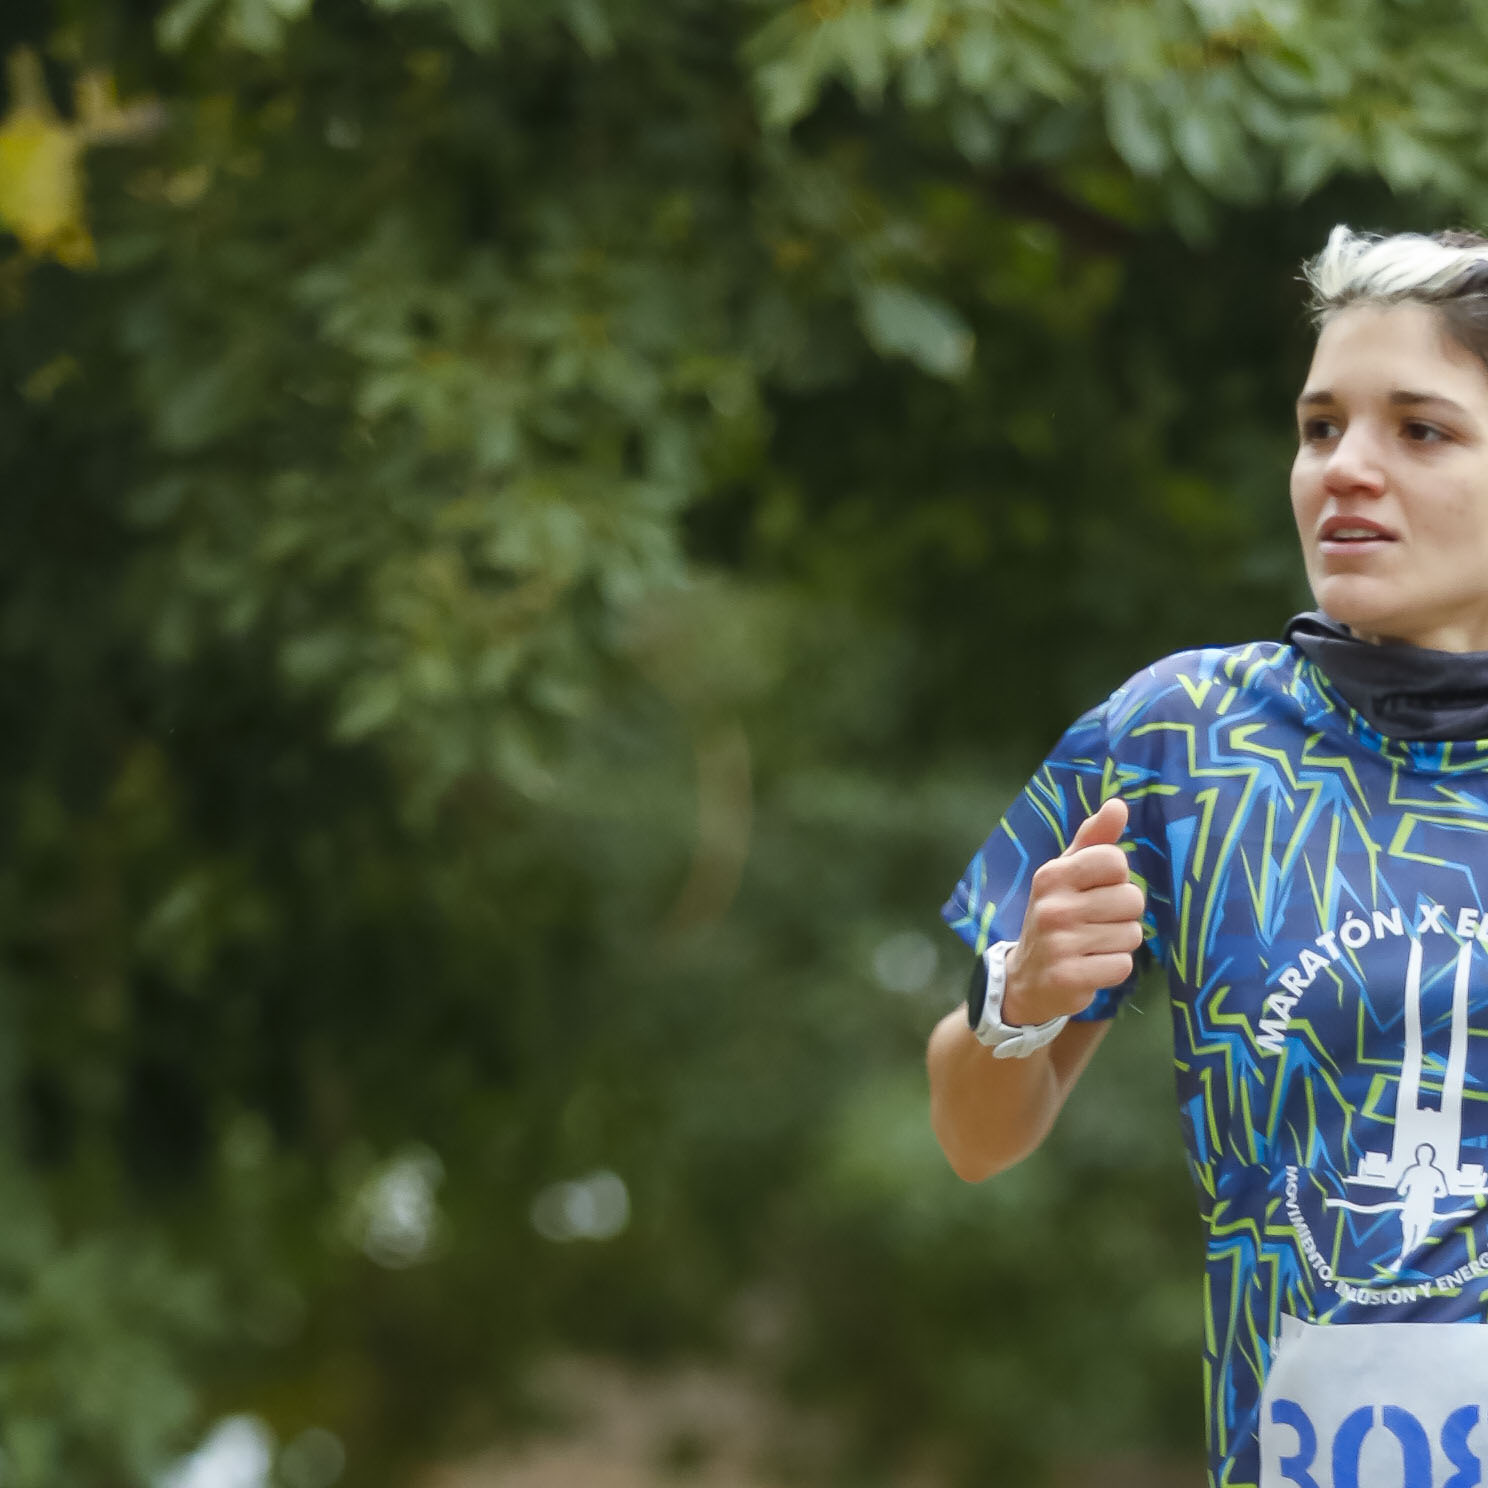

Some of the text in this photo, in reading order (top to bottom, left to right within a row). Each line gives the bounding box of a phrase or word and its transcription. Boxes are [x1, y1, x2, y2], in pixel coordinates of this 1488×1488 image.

[1256, 908, 1404, 1054] MARATÓN
[1417, 905, 1445, 934] X
[1418, 1282, 1431, 1298] Y
